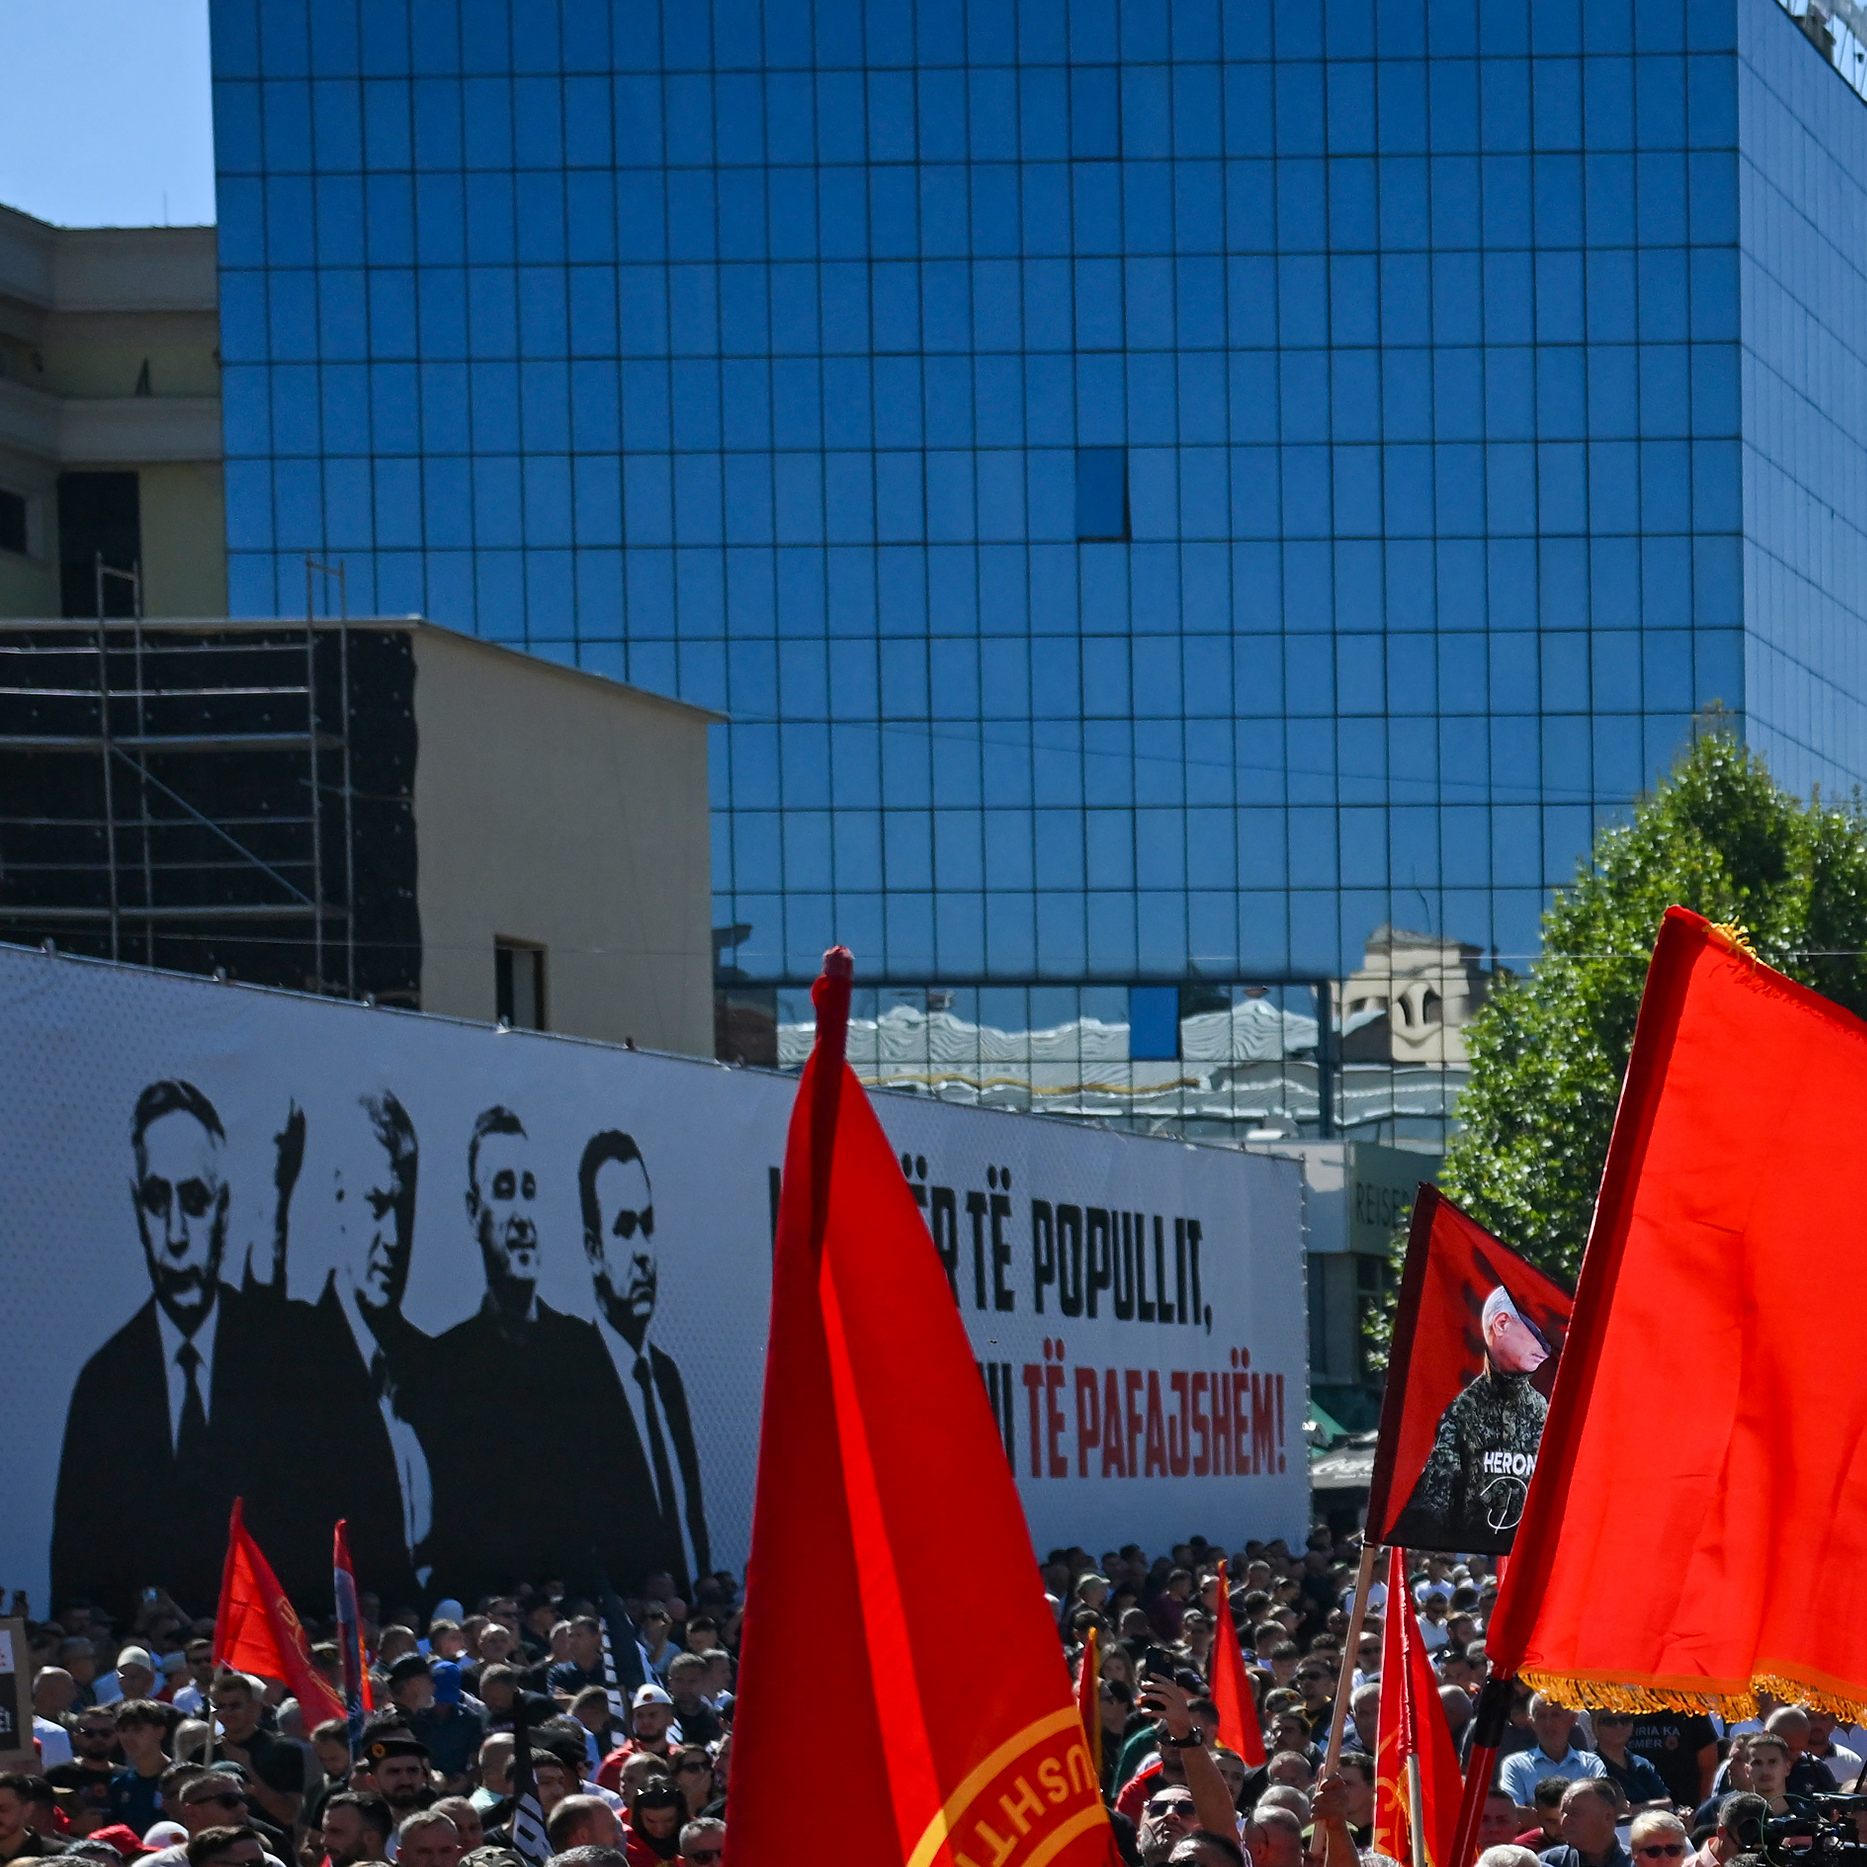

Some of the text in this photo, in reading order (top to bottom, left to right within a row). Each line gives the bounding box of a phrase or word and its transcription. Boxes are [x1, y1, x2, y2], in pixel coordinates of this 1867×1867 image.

[967, 1165, 1015, 1313] TË
[1031, 1198, 1213, 1335] POPULLIT,
[1023, 1337, 1068, 1479] TË
[1074, 1346, 1287, 1479] PAFAJSHËM!
